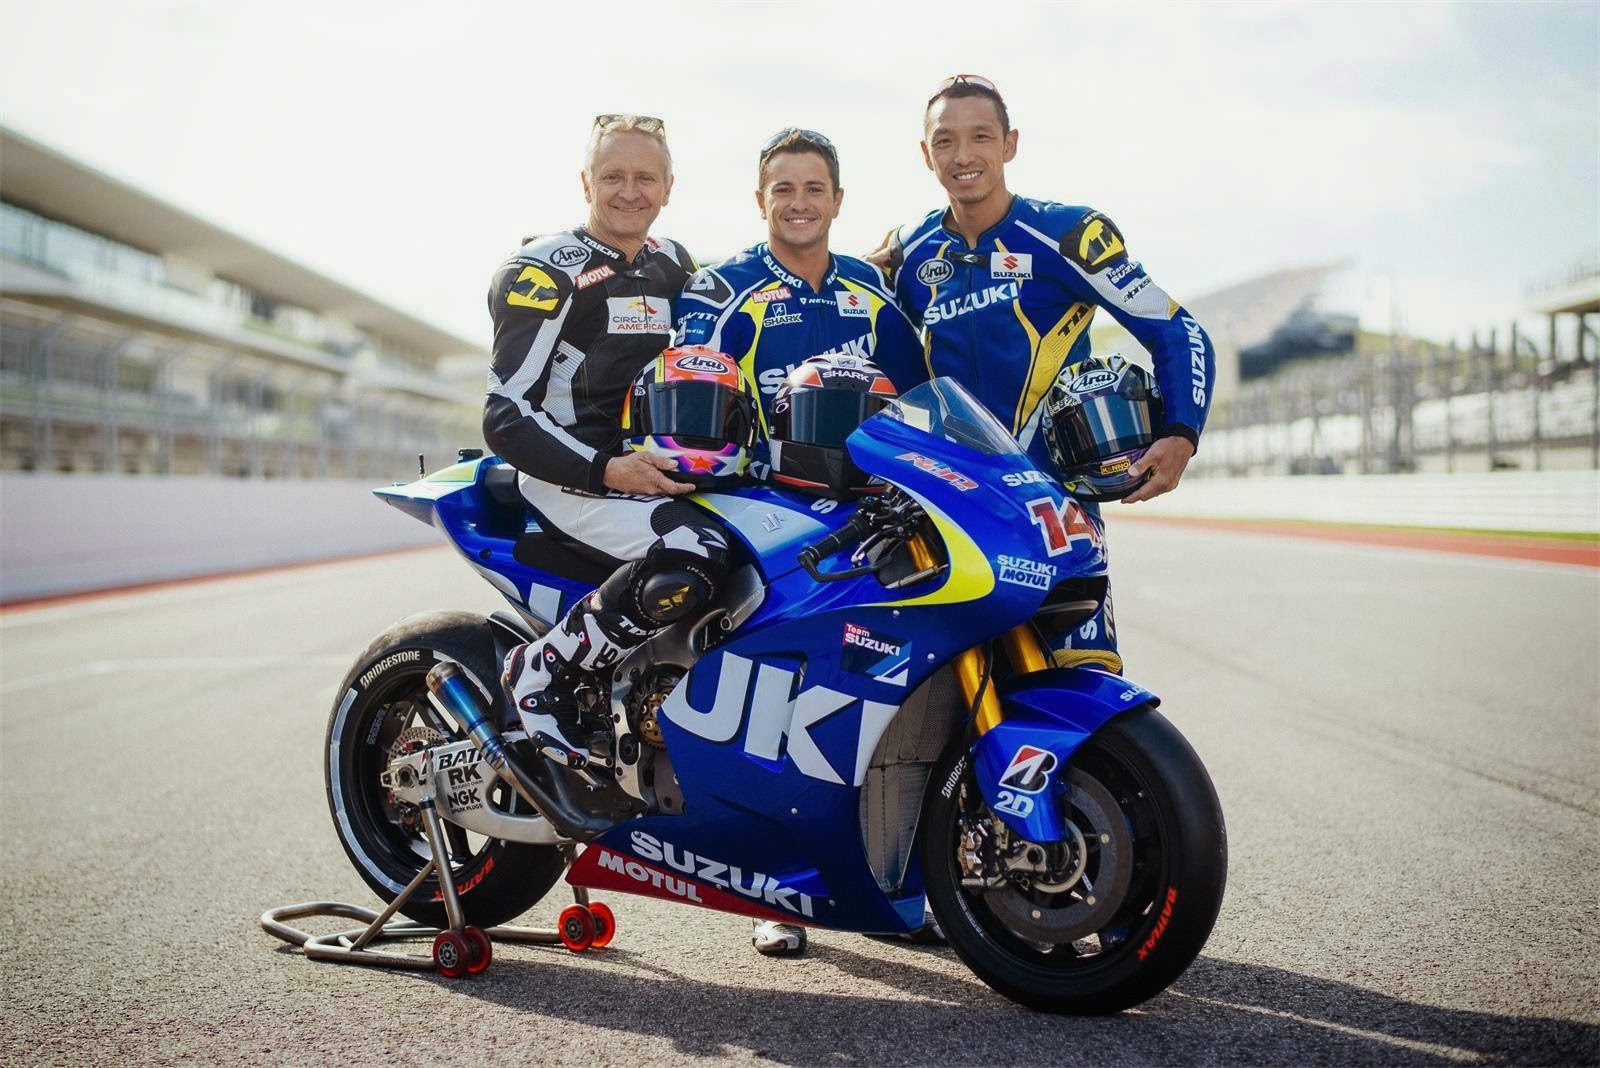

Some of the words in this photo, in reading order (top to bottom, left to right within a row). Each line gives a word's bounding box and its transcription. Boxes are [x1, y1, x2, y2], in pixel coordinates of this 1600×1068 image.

[556, 246, 586, 265] Arai
[582, 235, 621, 260] TAICHI
[577, 265, 616, 290] MOTUL
[763, 254, 803, 289] SUZUKI
[920, 262, 949, 280] Arai
[993, 271, 1031, 279] SUZUKI
[753, 289, 790, 303] MOTUL
[923, 281, 1019, 326] SUZUKI
[612, 315, 654, 324] CIRCUIT
[764, 313, 802, 328] SHARK
[842, 308, 868, 316] SUZUKI
[680, 356, 723, 370] Arai
[1181, 315, 1207, 408] SUZUKI
[822, 370, 870, 383] SHARK
[1076, 373, 1113, 391] Arai
[1025, 496, 1101, 558] 14
[996, 554, 1057, 577] SUZUKI
[1002, 569, 1048, 588] MOTUL
[845, 623, 870, 638] Team
[844, 632, 901, 657] SUZUKI
[359, 650, 421, 690] BRIDGESTONE
[447, 762, 482, 786] RK
[446, 787, 481, 809] NGK
[994, 790, 1035, 819] 2D
[597, 849, 703, 904] MOTUL
[629, 830, 814, 918] SUZUKI
